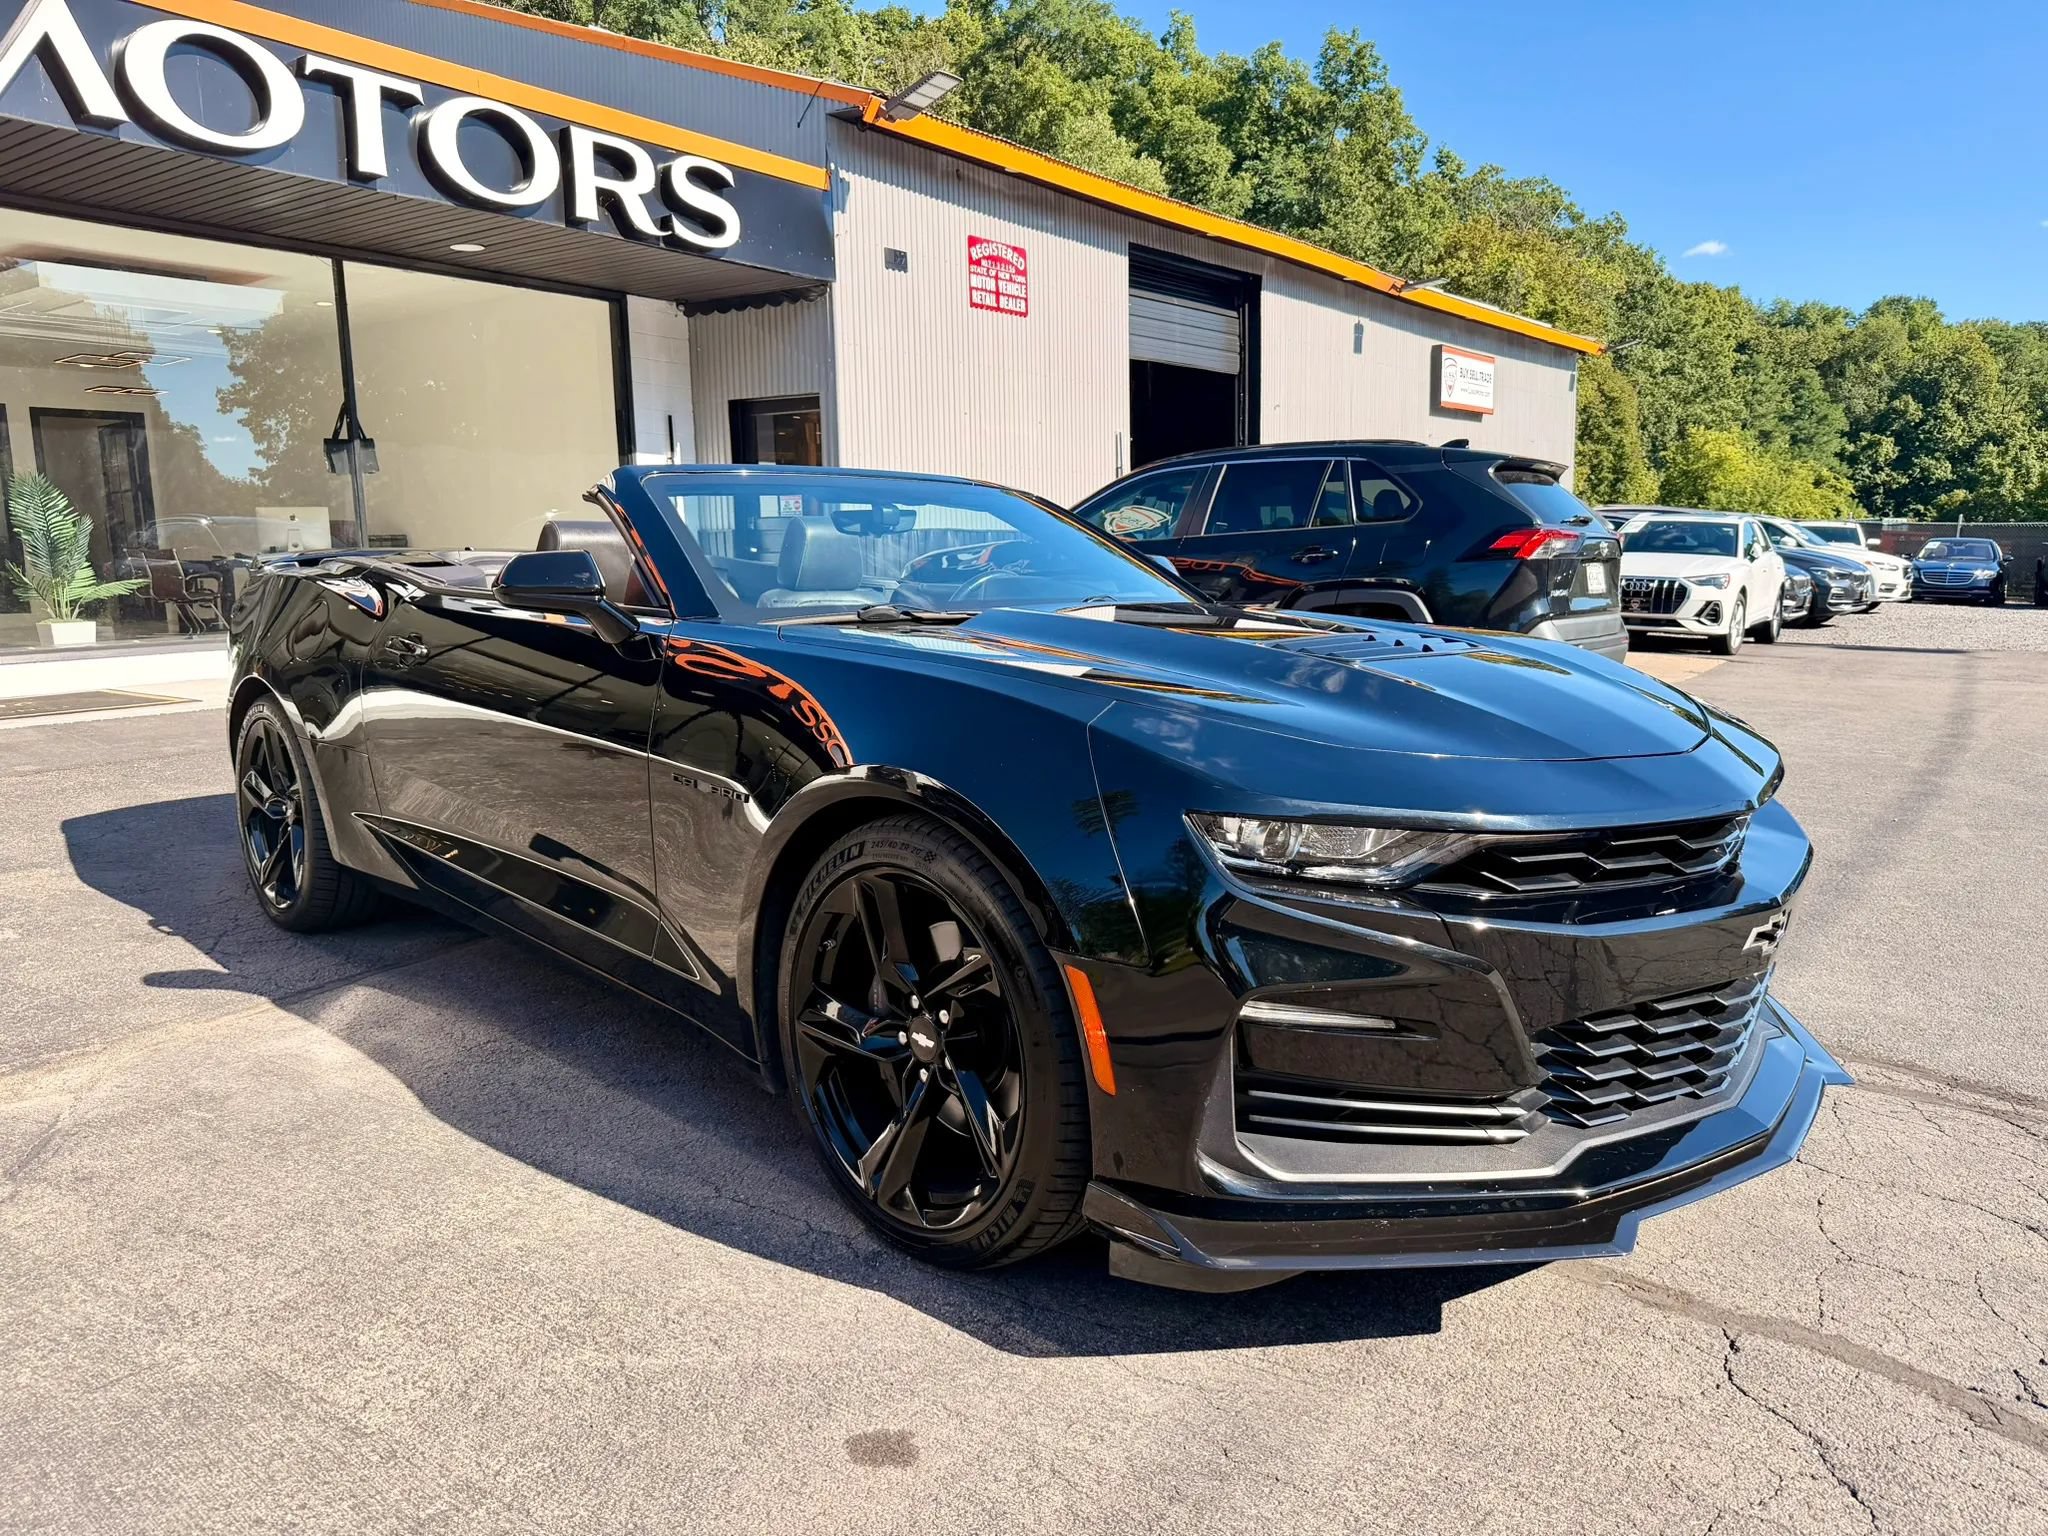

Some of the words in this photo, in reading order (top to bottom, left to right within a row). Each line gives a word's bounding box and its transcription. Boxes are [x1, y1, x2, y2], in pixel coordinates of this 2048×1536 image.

[970, 243, 1025, 270] REGISTERED
[970, 265, 988, 276] STATE
[989, 269, 997, 277] OF
[998, 271, 1010, 280] NEW
[1011, 274, 1026, 283] YORK
[970, 275, 997, 291] MOTOR
[998, 279, 1027, 297] VEHICLE
[971, 290, 998, 307] RETAIL
[999, 295, 1027, 313] DEALER
[799, 842, 864, 911] MICHELIN
